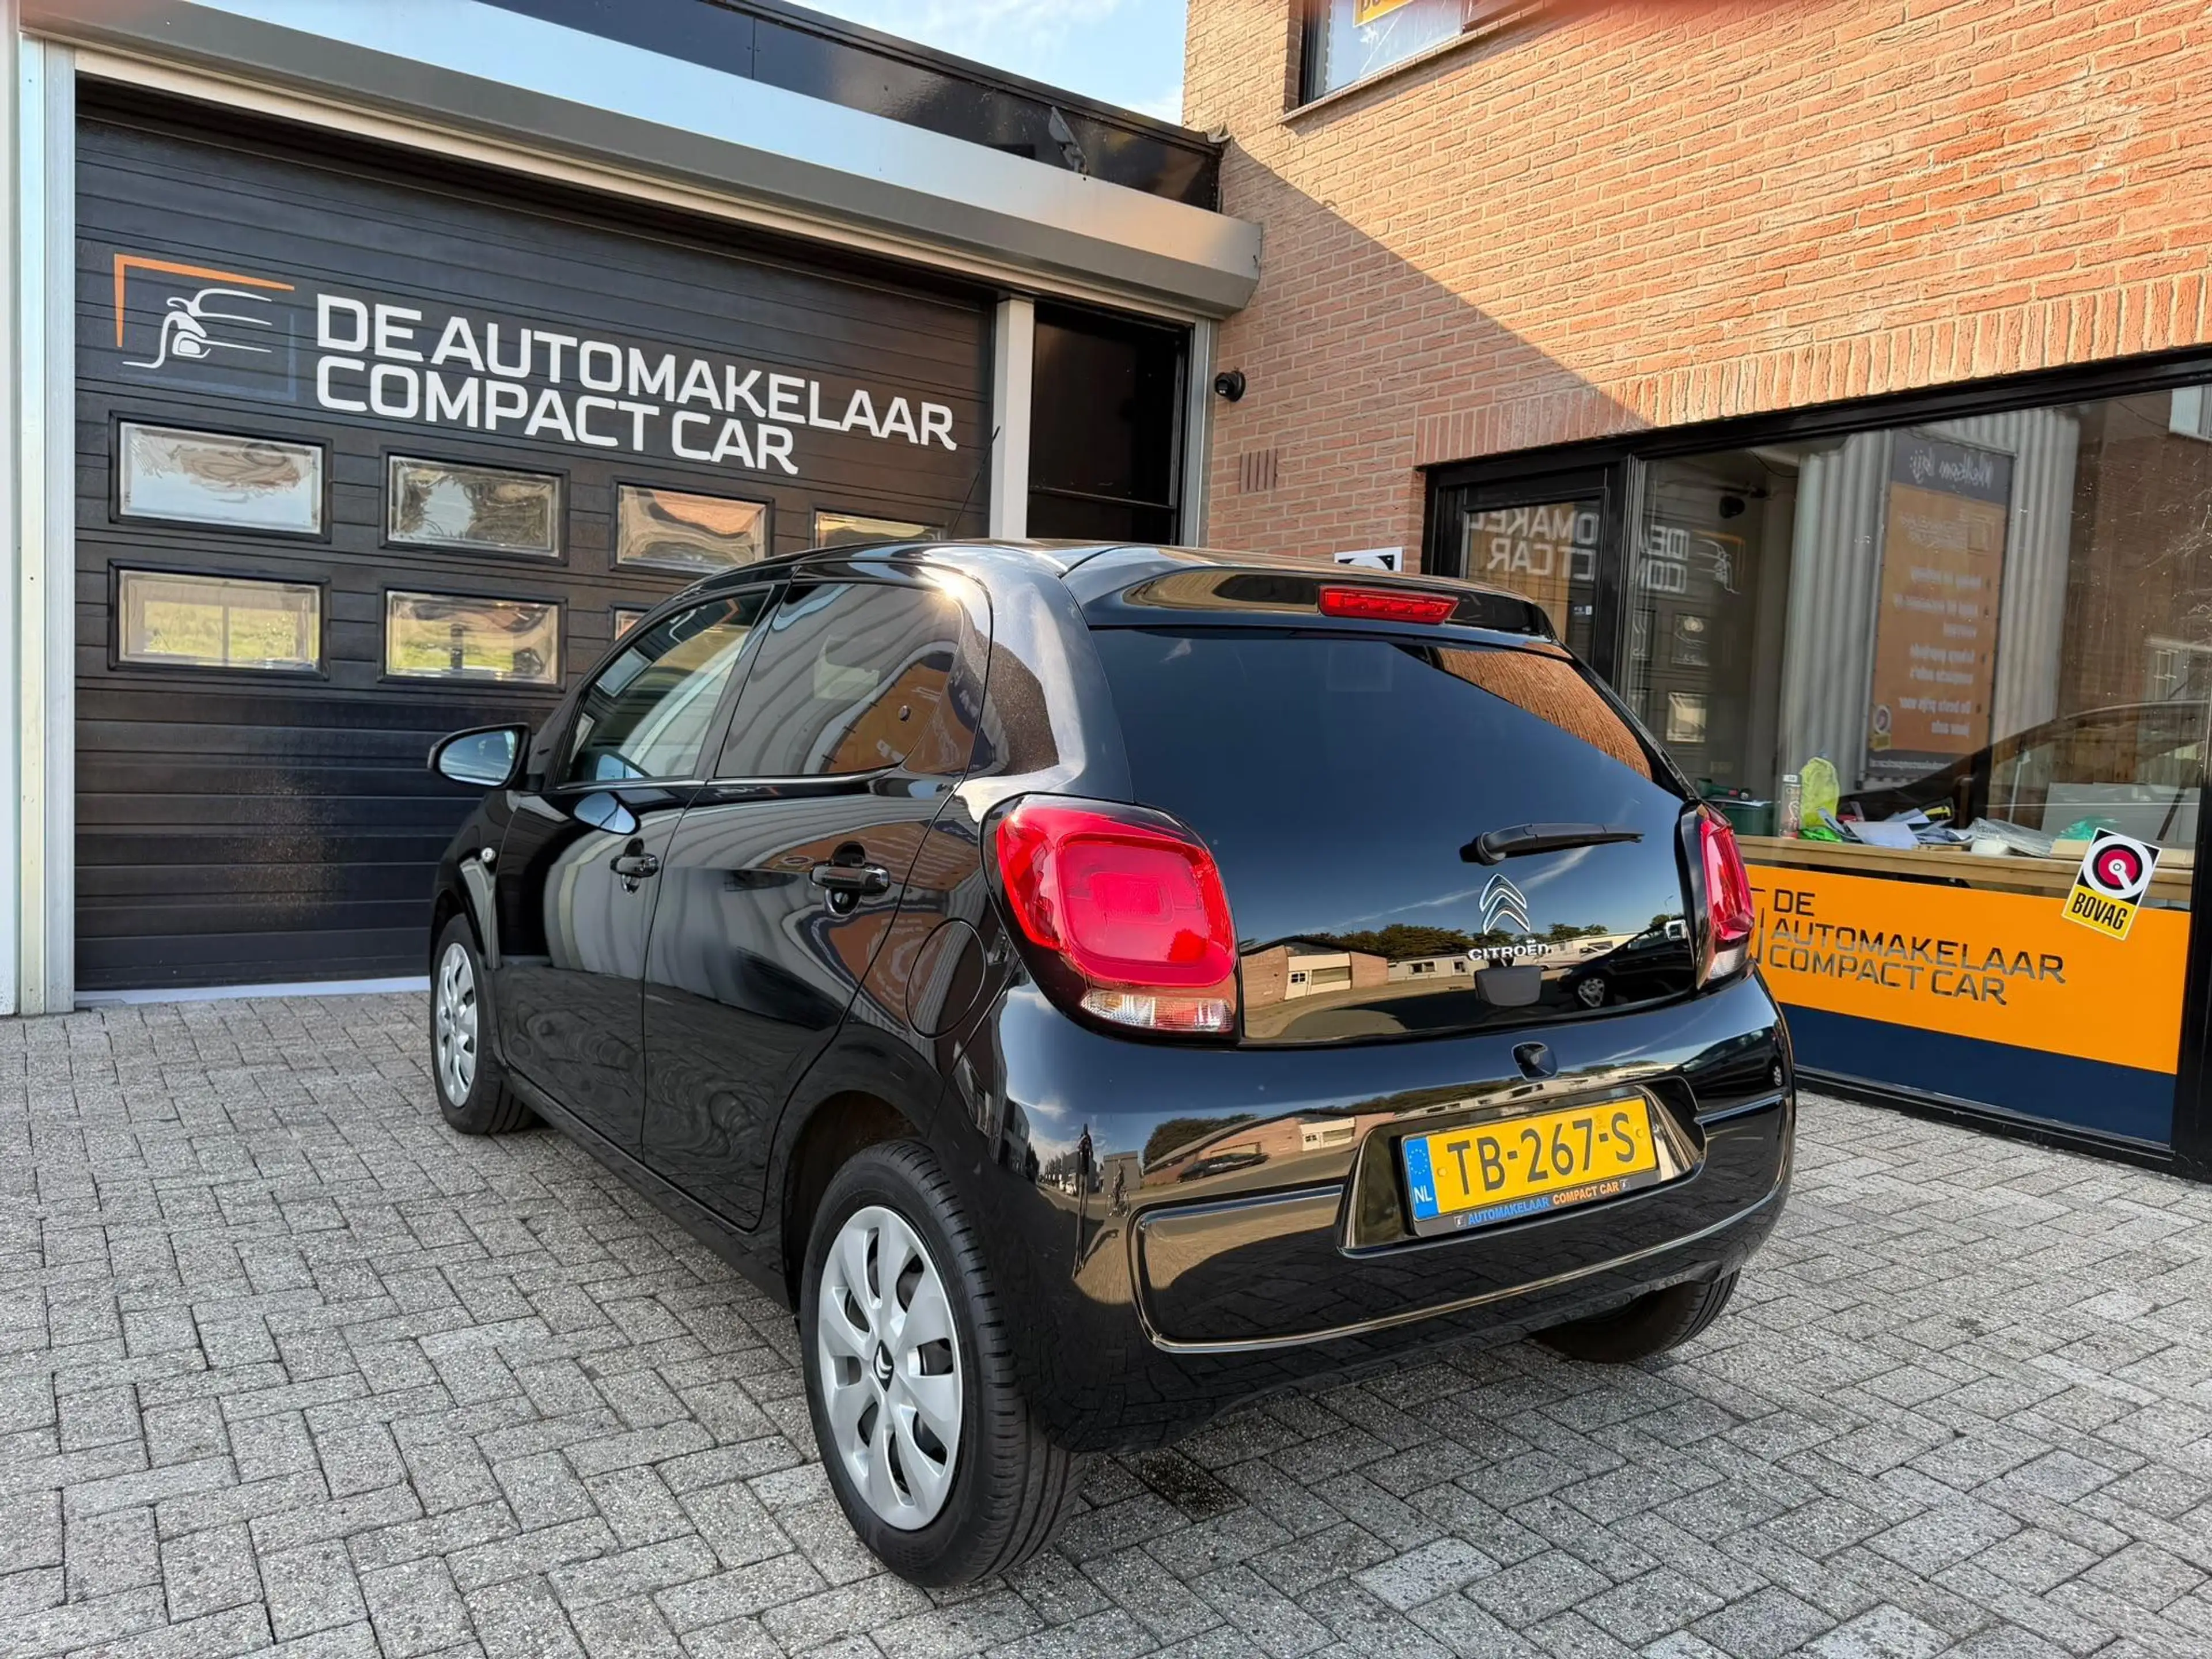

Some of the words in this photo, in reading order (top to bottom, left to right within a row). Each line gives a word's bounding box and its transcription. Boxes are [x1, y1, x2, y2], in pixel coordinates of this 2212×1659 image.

[317, 293, 424, 362] DE
[431, 315, 957, 451] AUTOMAKELAAR
[317, 355, 660, 452] COMPACT
[672, 410, 799, 475] CAR
[1773, 889, 1815, 917] DE
[2071, 892, 2128, 931] BOVAG
[1768, 944, 1926, 991] COMPACT
[1931, 970, 2007, 1005] CAR
[1770, 918, 2066, 984] AUTOMAKELAAR
[1447, 1112, 1635, 1196] TB-267-S
[1414, 1186, 1433, 1204] NL
[1467, 1197, 1550, 1226] AUTOMAKELAAR
[1552, 1185, 1597, 1206] COMPACT
[1600, 1181, 1619, 1195] CAR
